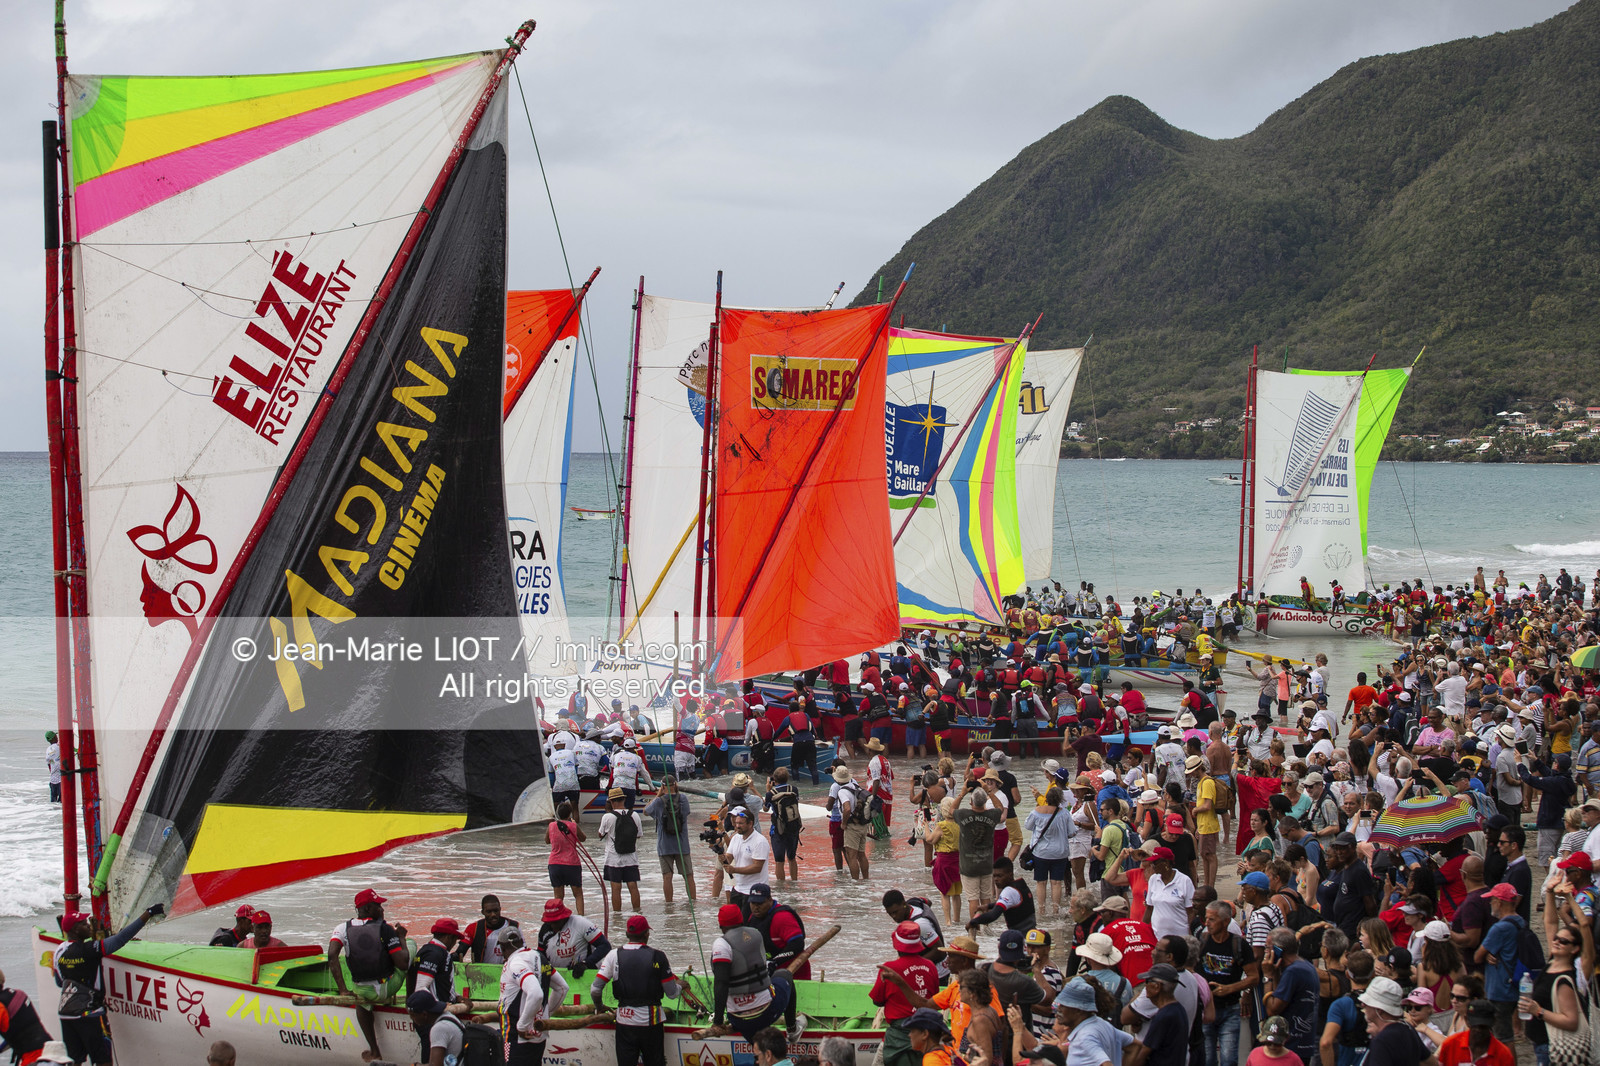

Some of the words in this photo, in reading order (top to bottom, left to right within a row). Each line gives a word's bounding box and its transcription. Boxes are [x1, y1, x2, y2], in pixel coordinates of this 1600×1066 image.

[212, 249, 326, 430] ÉLIZÉ
[259, 258, 357, 446] RESTAURANT
[679, 349, 699, 379] Parc
[754, 366, 856, 401] SOMAREC
[894, 459, 920, 476] Mare
[269, 326, 469, 713] MADIANA
[378, 463, 447, 592] CINÉMA
[596, 660, 641, 673] Polymar
[108, 966, 168, 1011] LIZÉ
[226, 992, 359, 1038] MADIANA
[384, 1019, 408, 1032] VILLE
[279, 1030, 332, 1051] CINÉMA
